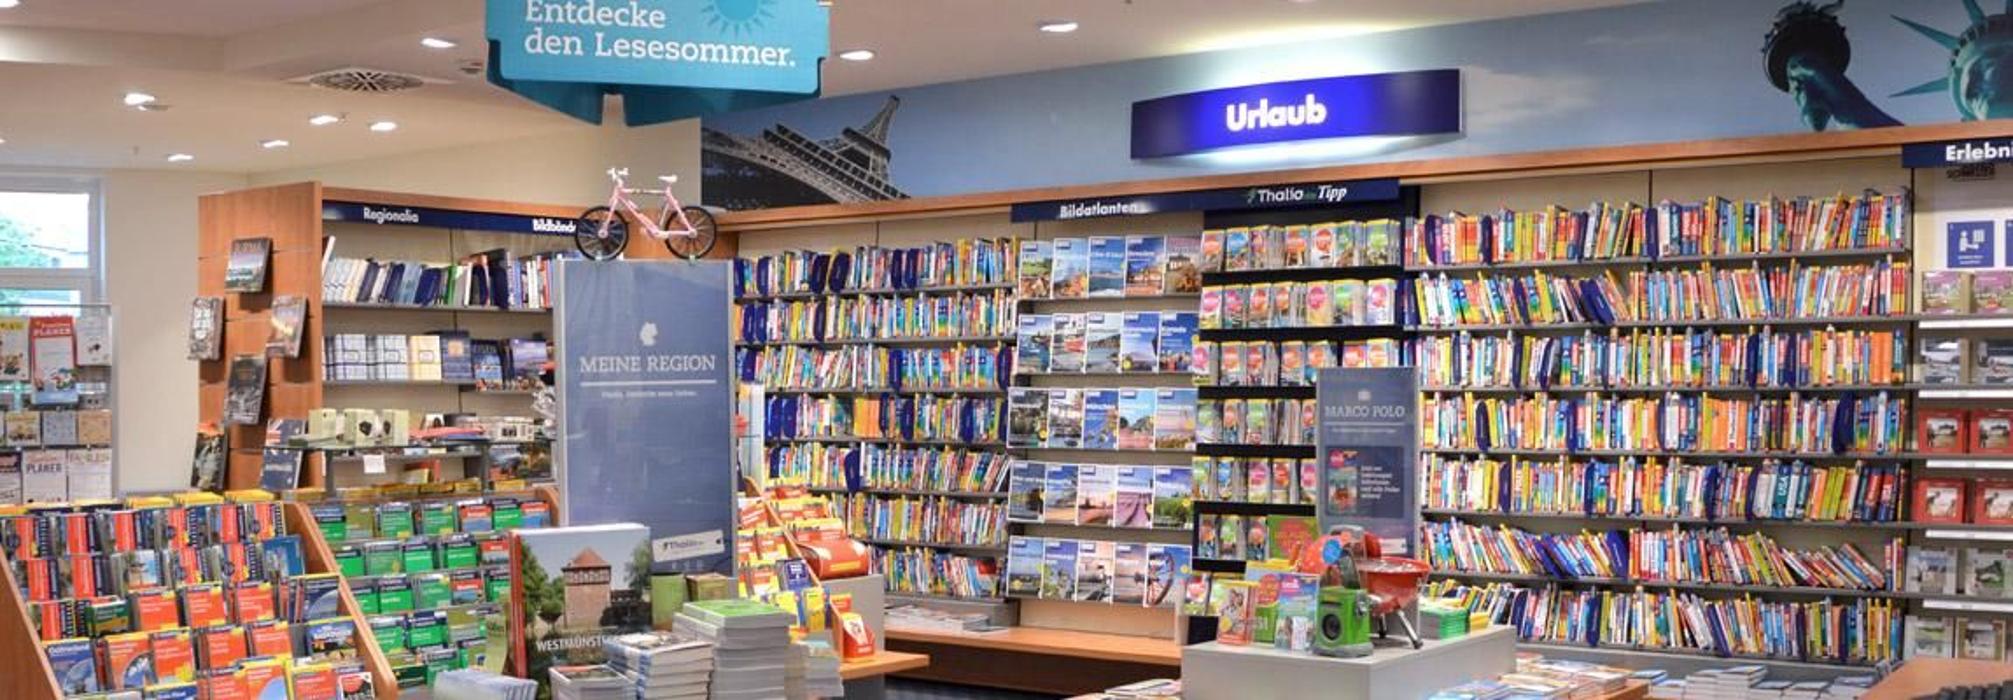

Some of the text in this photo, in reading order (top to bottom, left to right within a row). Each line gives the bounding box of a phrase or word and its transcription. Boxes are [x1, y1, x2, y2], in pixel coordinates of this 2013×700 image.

[525, 0, 666, 29] Entdecke
[524, 28, 796, 67] den Lesesommer.
[1225, 94, 1327, 132] Urlaub
[1317, 185, 1348, 202] Tipp
[363, 207, 419, 225] Regionalia
[1060, 201, 1138, 219] Bildatlanten
[579, 355, 716, 372] MEINE REGION
[1325, 405, 1405, 417] MARCO POLO
[1777, 475, 1790, 497] USA
